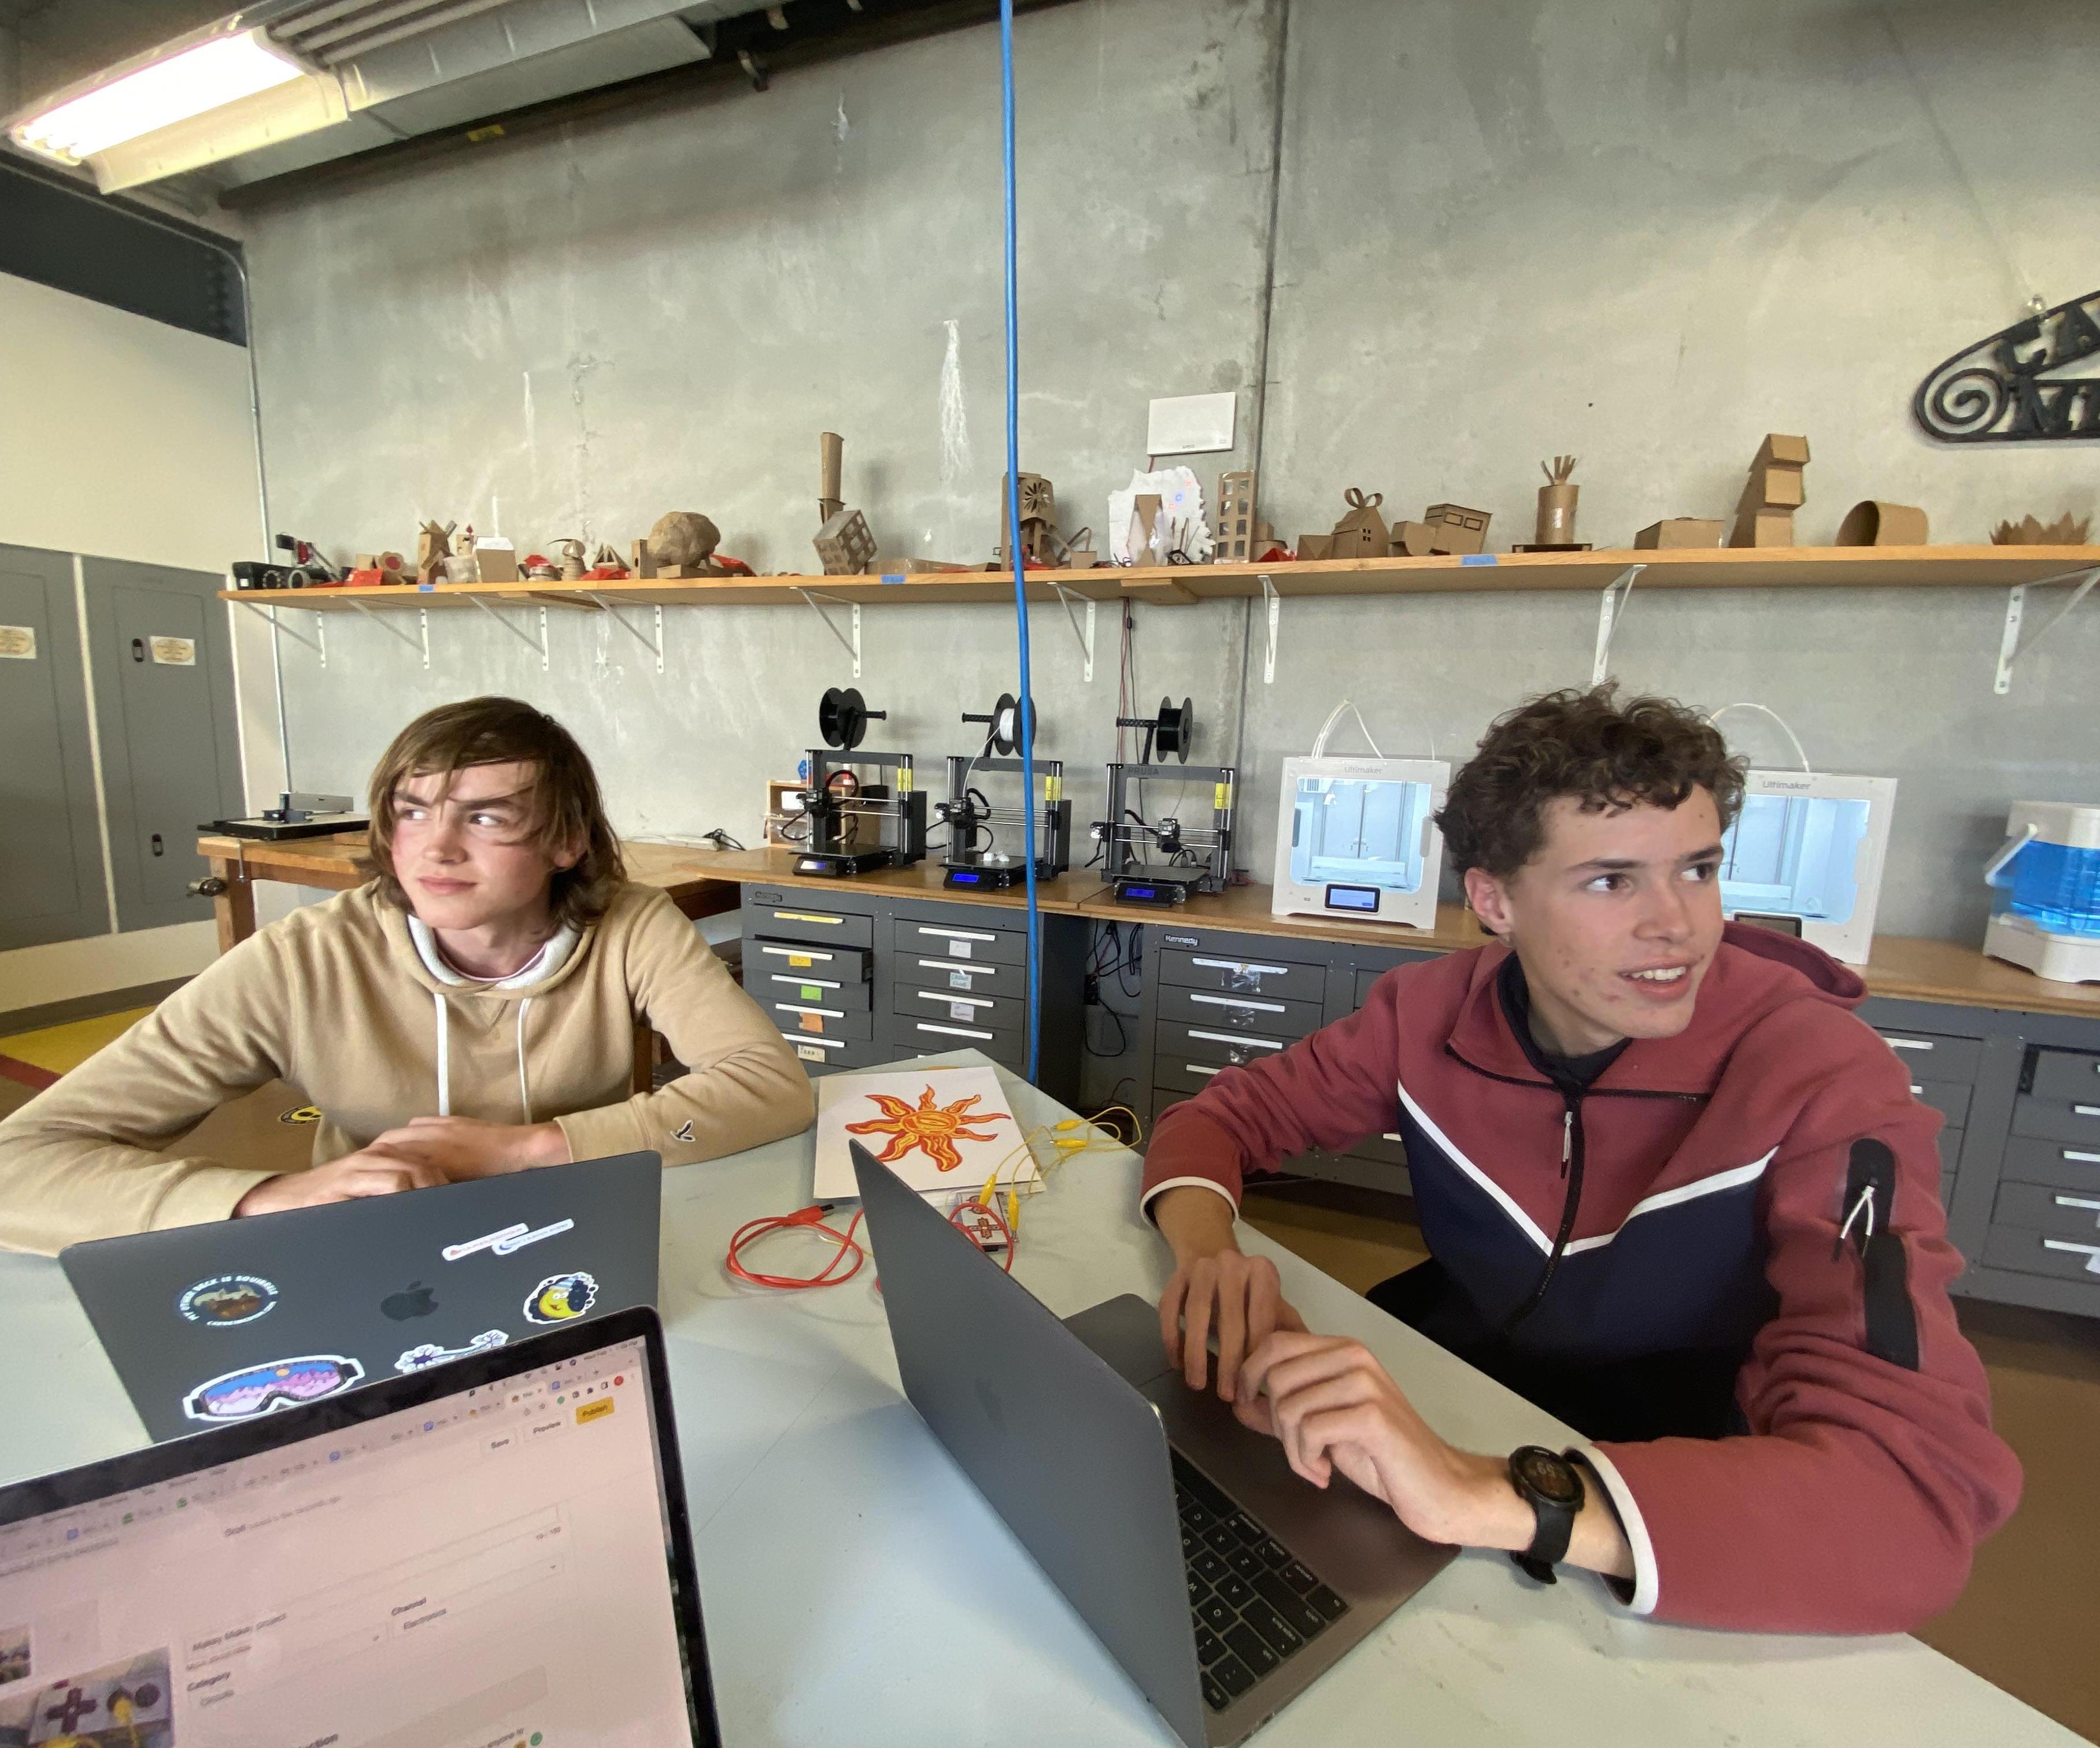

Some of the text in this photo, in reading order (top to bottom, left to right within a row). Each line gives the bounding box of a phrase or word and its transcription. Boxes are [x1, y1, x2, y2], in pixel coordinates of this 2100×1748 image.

[1344, 766, 1384, 774] Ultimaker
[1762, 781, 1811, 790] Ultimaker
[1165, 935, 1198, 946] Kennedy
[533, 1421, 561, 1434] Preview
[491, 1438, 509, 1449] Save
[1188, 1583, 1197, 1593] W
[1232, 1584, 1240, 1593] A
